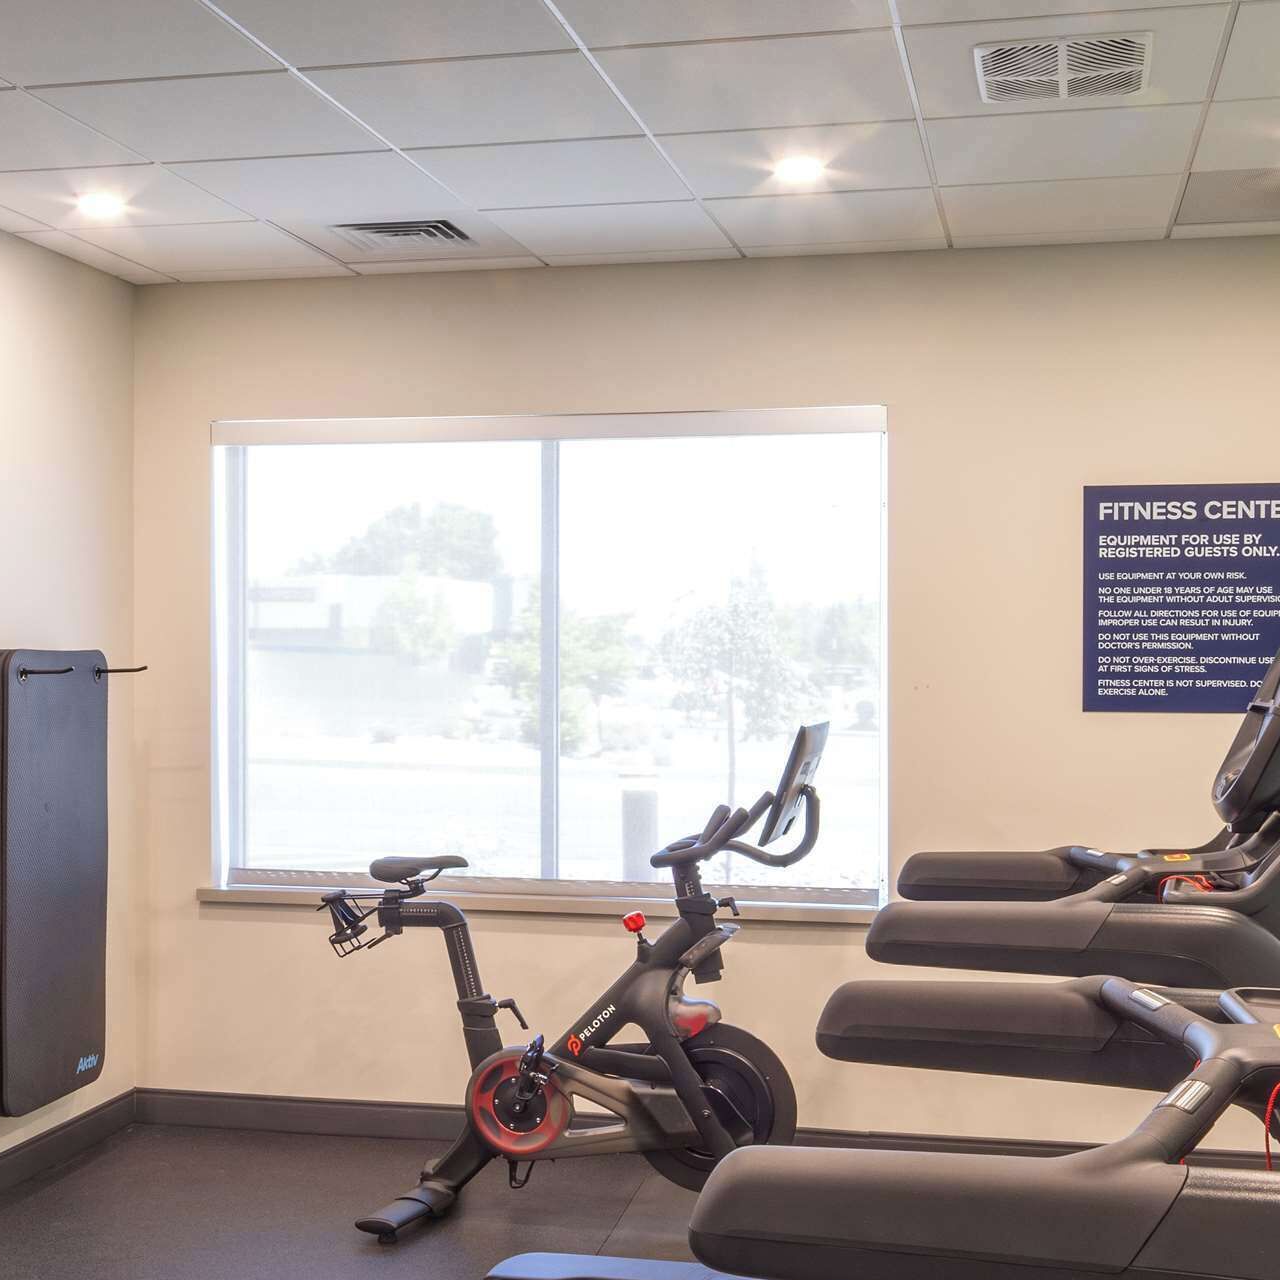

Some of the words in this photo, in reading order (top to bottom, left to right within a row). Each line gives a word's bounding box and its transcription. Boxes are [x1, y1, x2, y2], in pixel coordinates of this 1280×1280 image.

[1100, 501, 1197, 520] FITNESS
[1099, 535, 1178, 547] EQUIPMENT
[1182, 534, 1208, 546] FOR
[1213, 534, 1239, 546] USE
[1244, 534, 1262, 546] BY
[1099, 547, 1180, 558] REGISTERED
[1184, 546, 1238, 558] GUESTS
[1242, 546, 1280, 557] ONLY.
[1098, 572, 1114, 580] USE
[1116, 572, 1164, 580] EQUIPMENT
[1166, 572, 1176, 580] AT
[1178, 572, 1202, 580] YOUR
[1203, 572, 1224, 580] OWN
[1226, 572, 1246, 580] RISK.
[1098, 587, 1111, 595] NO
[1113, 587, 1130, 595] ONE
[1133, 587, 1162, 595] UNDER
[1164, 587, 1172, 595] 18
[1174, 587, 1201, 595] YEARS
[1203, 587, 1215, 595] OF
[1216, 587, 1234, 595] AGE
[1236, 587, 1254, 595] MAY
[1256, 586, 1272, 594] USE
[1098, 596, 1114, 604] THE
[1116, 596, 1164, 604] EQUIPMENT
[1166, 596, 1204, 604] WITHOUT
[1206, 596, 1232, 604] ADULT
[1098, 610, 1132, 618] FOLLOW
[1134, 610, 1148, 618] ALL
[1150, 610, 1199, 618] DIRECTIONS
[1202, 610, 1218, 618] FOR
[1220, 610, 1237, 618] USE
[1239, 610, 1251, 618] OF
[1098, 619, 1139, 627] IMPROPER
[1141, 619, 1157, 627] USE
[1160, 619, 1177, 627] CAN
[1180, 619, 1210, 627] RESULT
[1212, 619, 1220, 627] IN
[1222, 619, 1253, 627] INJURY.
[1098, 633, 1111, 641] DO
[1113, 633, 1130, 641] NOT
[1132, 633, 1148, 641] USE
[1151, 633, 1169, 641] THIS
[1171, 633, 1218, 641] EQUIPMENT
[1221, 633, 1259, 641] WITHOUT
[1098, 642, 1140, 650] DOCTOR'S
[1142, 642, 1193, 650] PERMISSION.
[1098, 656, 1111, 664] DO
[1113, 656, 1129, 664] NOT
[1132, 656, 1197, 664] OVER-EXERCISE.
[1200, 656, 1256, 664] DISCONTINUE
[1098, 665, 1108, 673] AT
[1110, 665, 1132, 673] FIRST
[1134, 665, 1159, 673] SIGNS
[1160, 665, 1172, 673] OF
[1174, 665, 1206, 673] STRESS.
[1098, 679, 1130, 687] FITNESS
[1132, 679, 1164, 687] CENTER
[1166, 679, 1174, 687] IS
[1176, 679, 1193, 687] NOT
[1196, 679, 1248, 687] SUPERVISED.
[1098, 688, 1136, 696] EXERCISE
[1138, 688, 1168, 696] ALONE.
[579, 1004, 616, 1041] PELOTON
[76, 1053, 99, 1073] Aktiv
